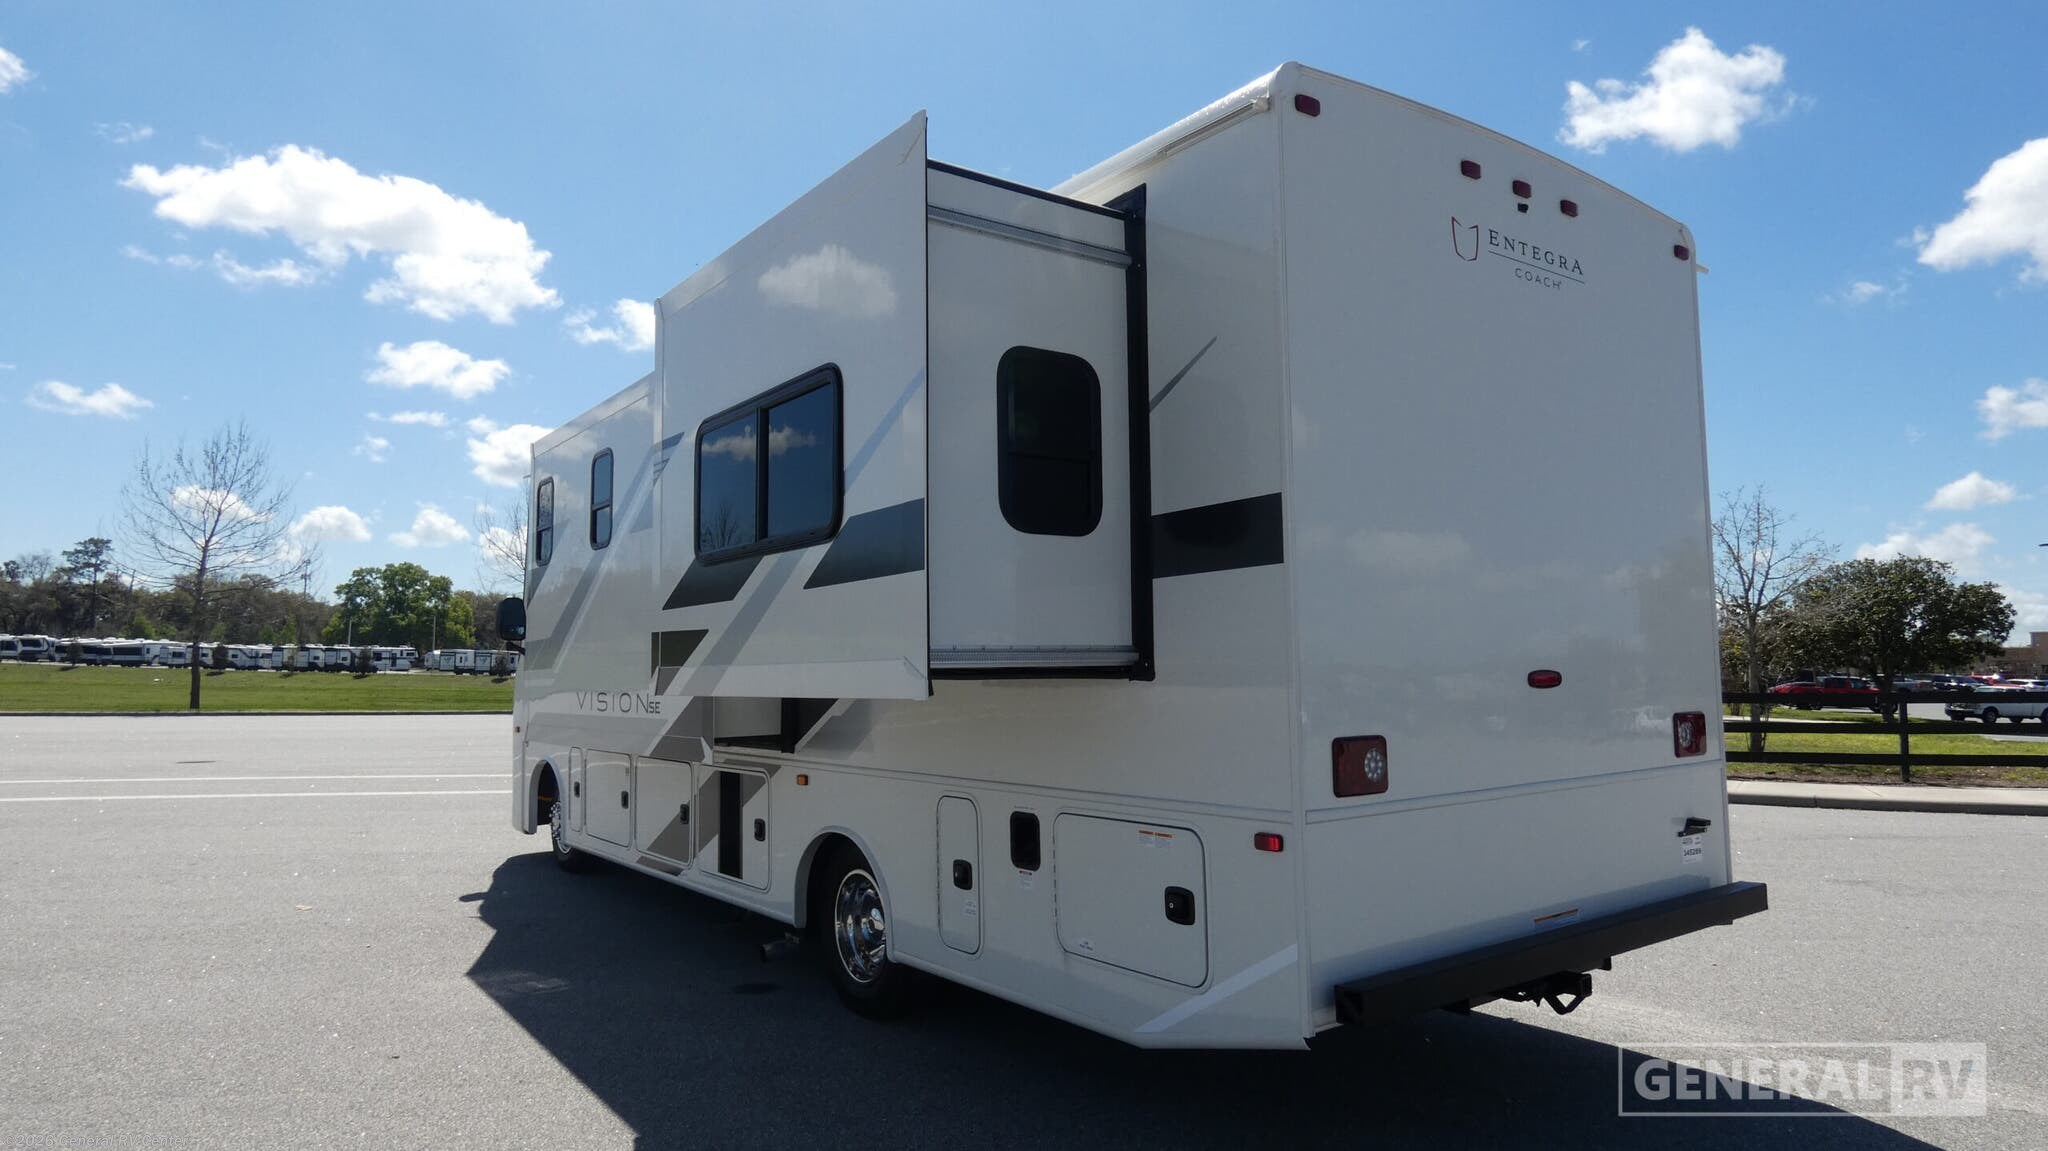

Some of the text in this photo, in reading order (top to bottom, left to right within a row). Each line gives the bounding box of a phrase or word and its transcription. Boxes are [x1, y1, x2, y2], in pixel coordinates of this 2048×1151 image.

[1488, 228, 1584, 275] ENTEGRA
[1514, 267, 1561, 290] COACH
[576, 691, 661, 714] VISION SE
